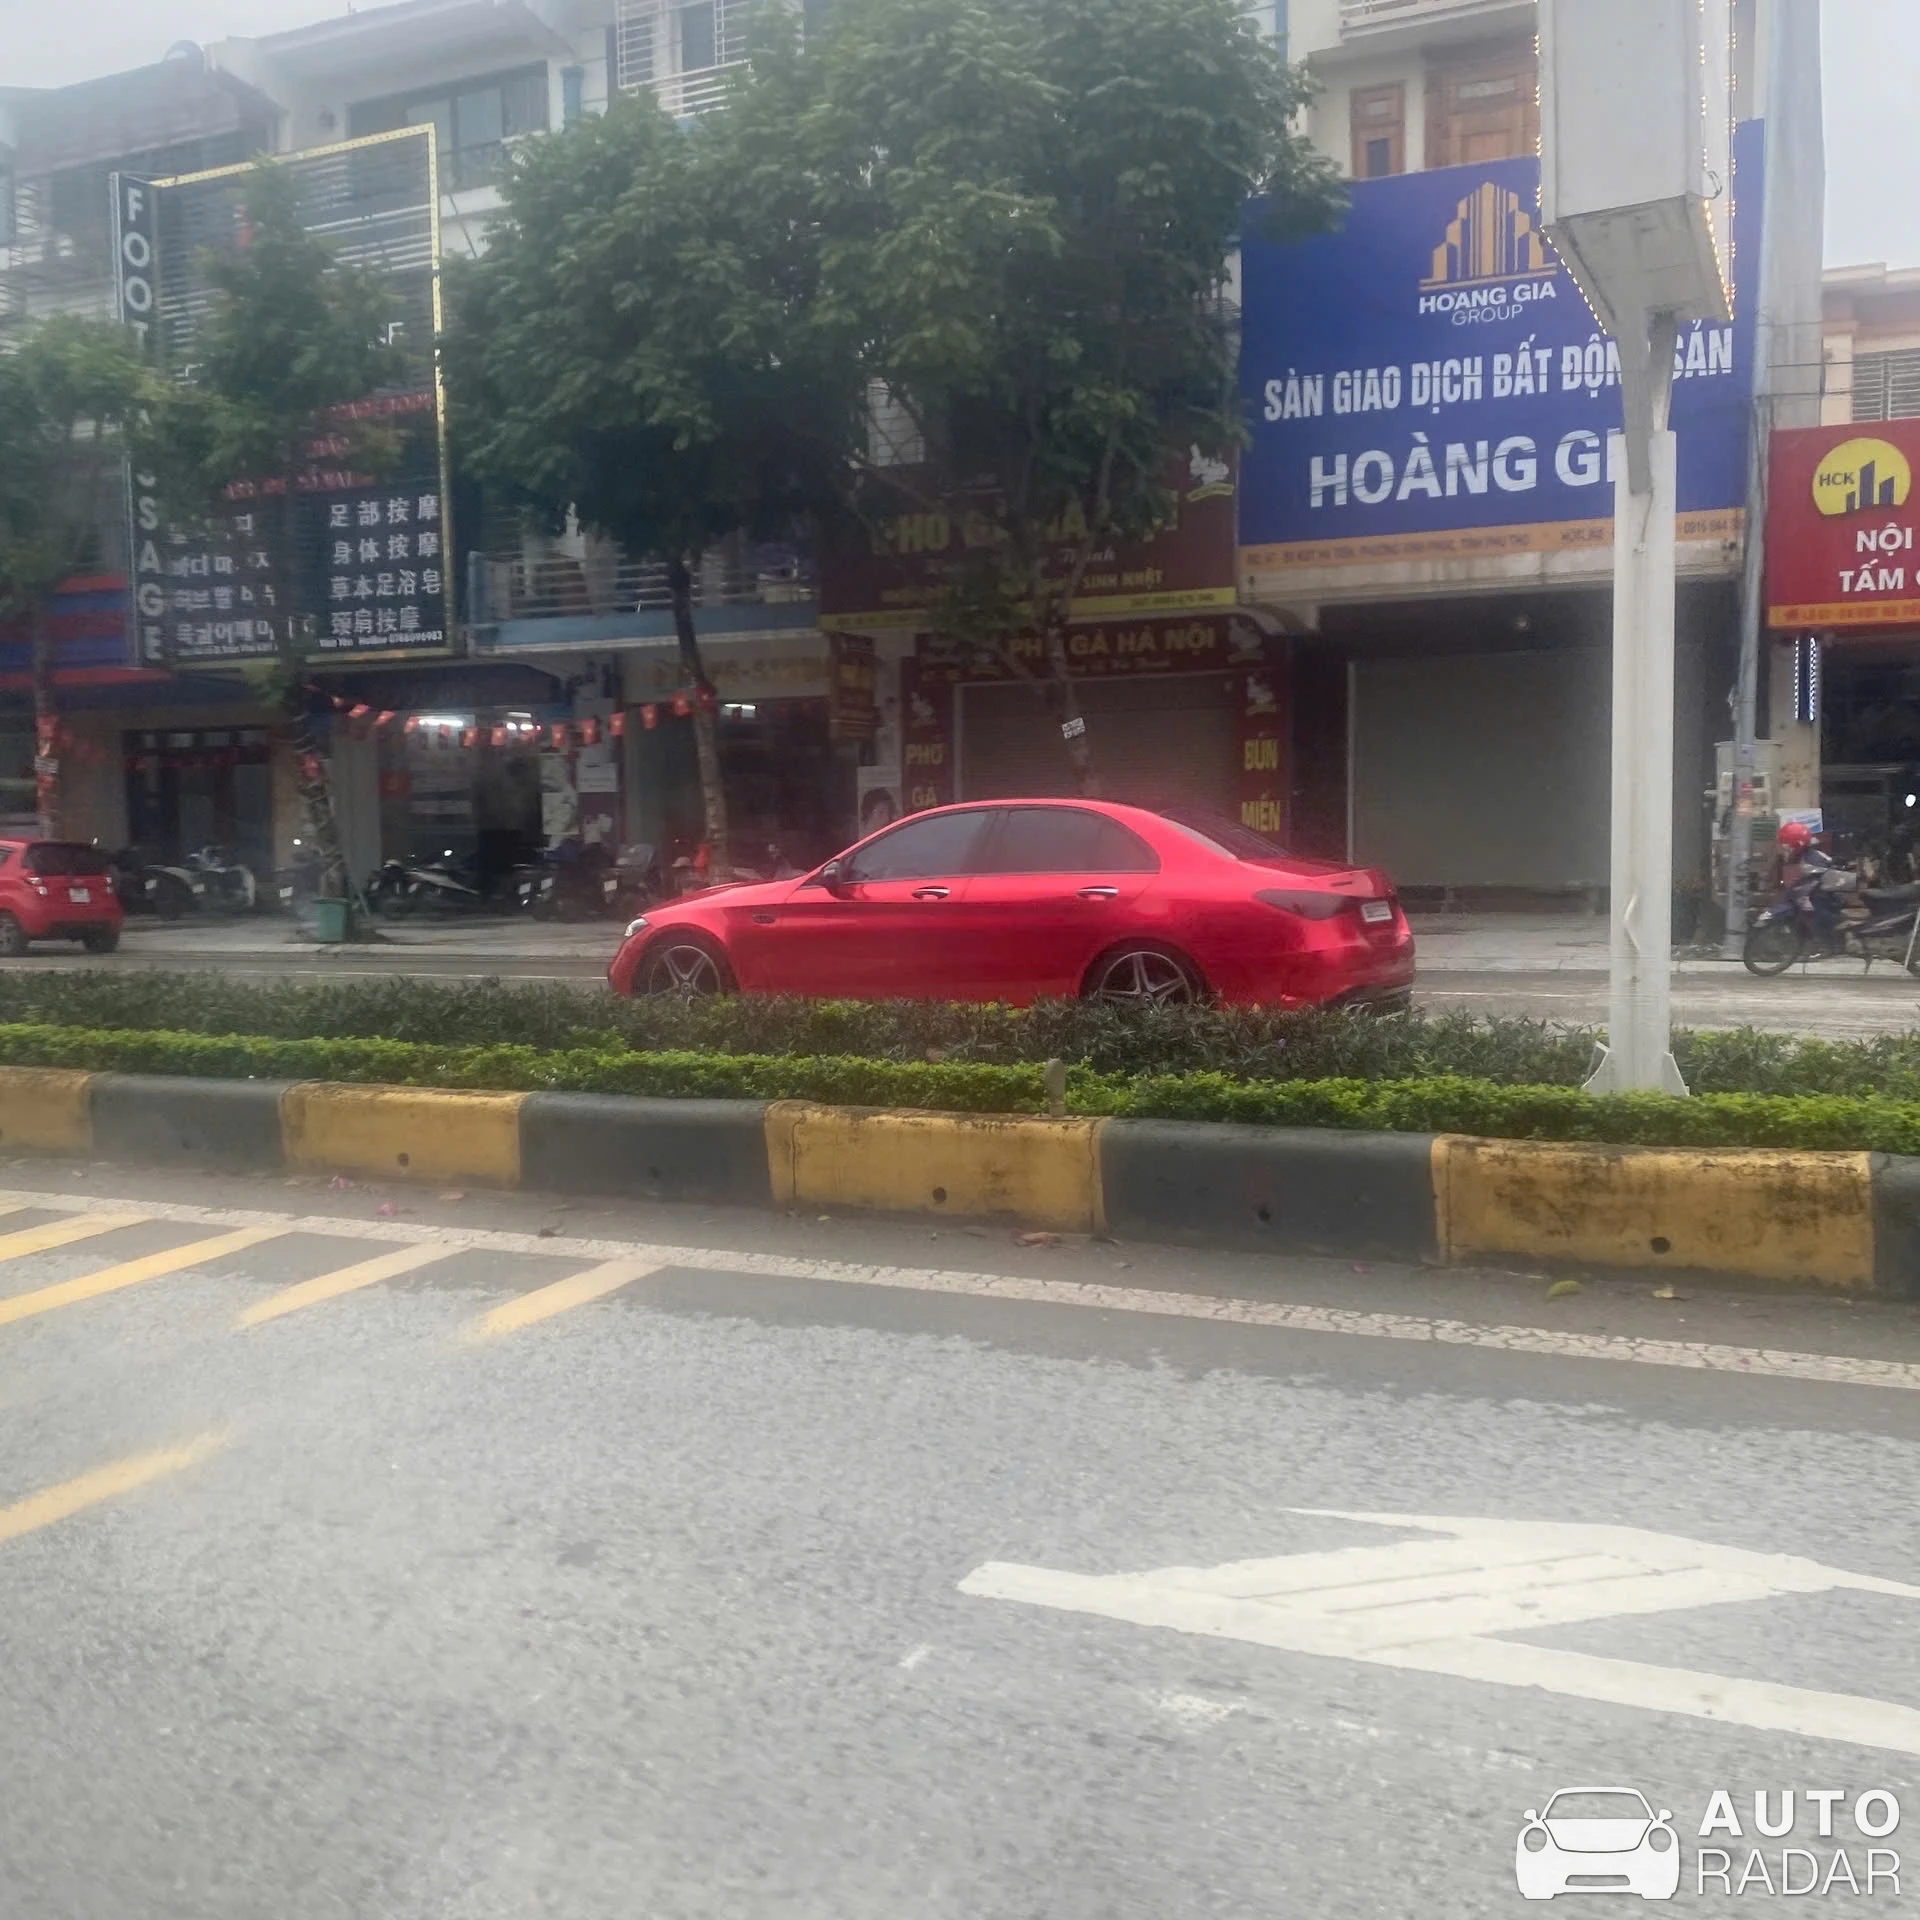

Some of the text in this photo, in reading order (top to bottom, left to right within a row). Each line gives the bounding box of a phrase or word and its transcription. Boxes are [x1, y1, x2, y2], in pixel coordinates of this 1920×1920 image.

[1513, 281, 1557, 302] GIA
[1451, 304, 1524, 326] GROUP
[1263, 367, 1324, 422] SÀN
[1333, 365, 1402, 415] GIAO
[1411, 356, 1484, 414] DỊCH
[1493, 333, 1553, 398] BẤT
[1561, 333, 1623, 398] ĐỘN
[1309, 428, 1621, 508] HOÀNG GI
[1819, 471, 1856, 487] HCK
[329, 494, 439, 529] 足部按摩
[333, 531, 440, 566] 身体按摩
[1856, 521, 1914, 557] NỘI
[1839, 558, 1905, 593] TẤM
[1069, 628, 1110, 655] GÀ
[1164, 621, 1217, 657] NỘI
